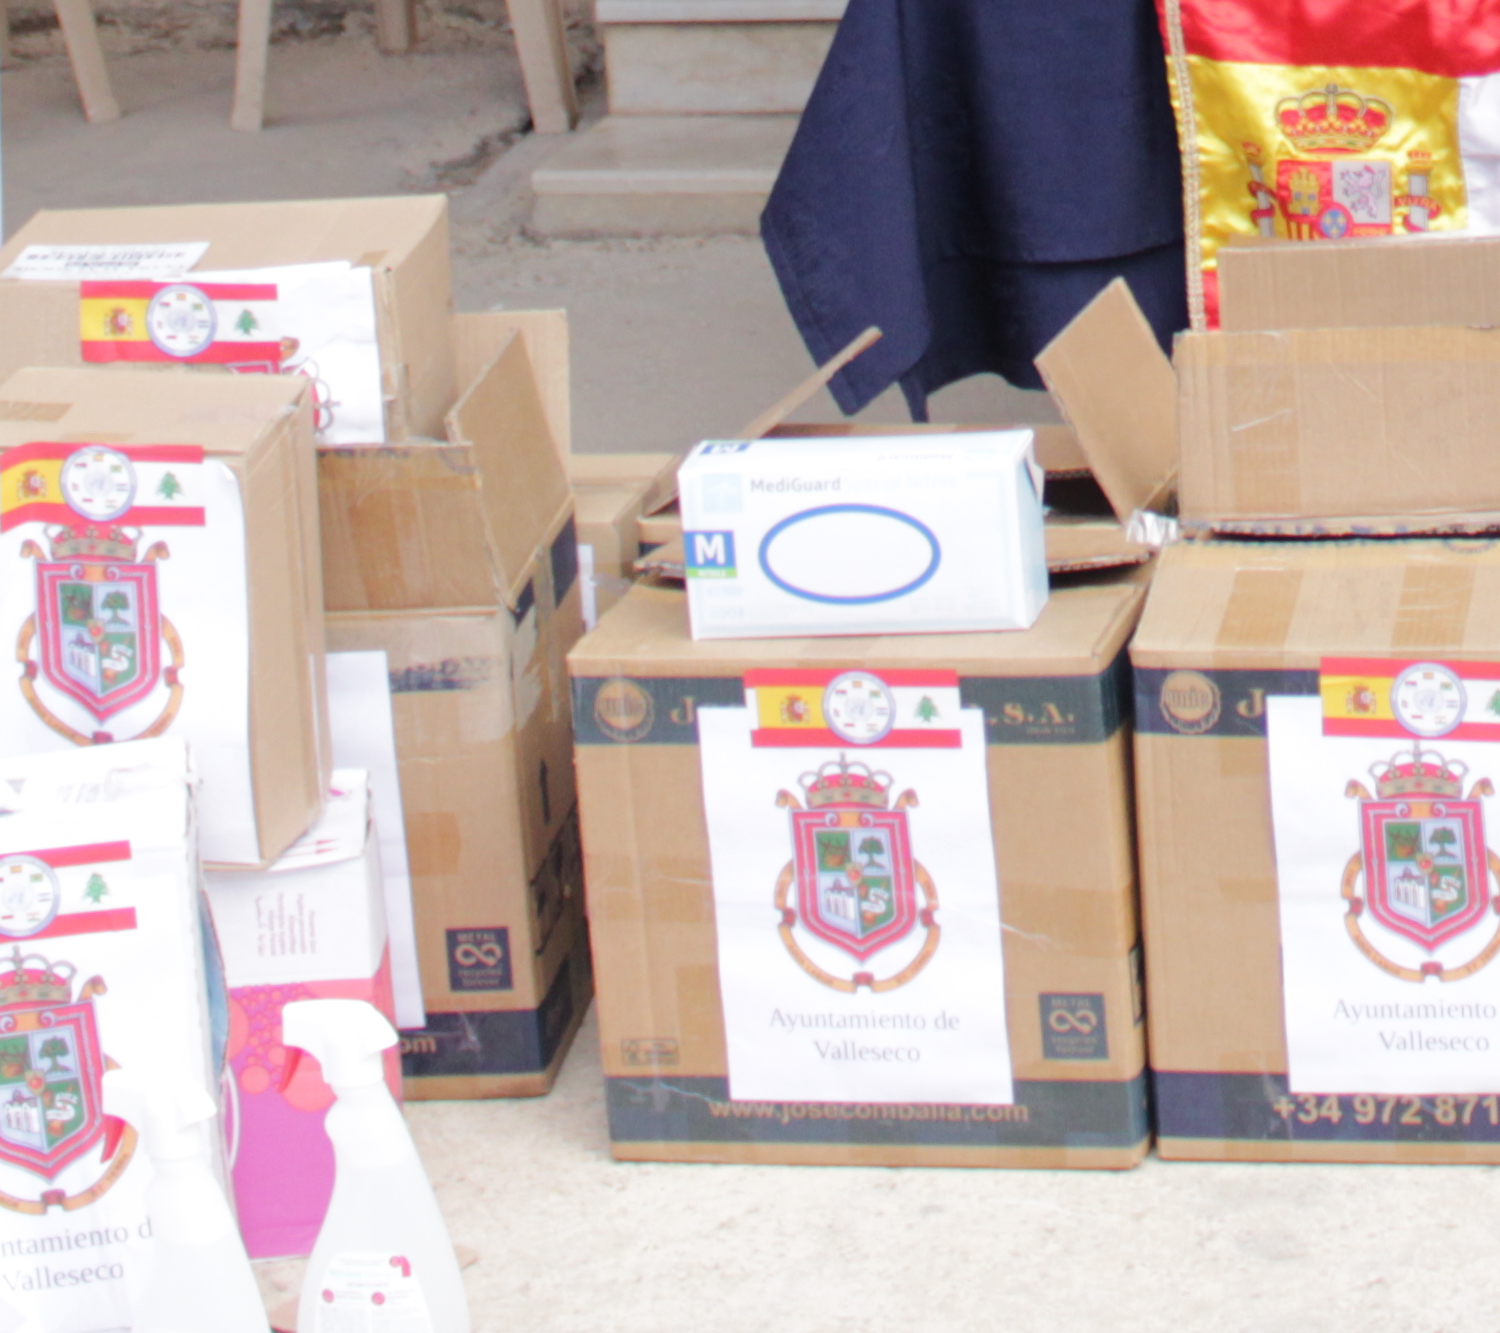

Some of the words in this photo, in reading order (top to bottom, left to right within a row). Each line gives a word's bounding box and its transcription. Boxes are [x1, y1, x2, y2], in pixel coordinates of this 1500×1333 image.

[749, 476, 842, 494] MediGuard
[694, 533, 727, 566] M
[768, 1008, 927, 1032] Ayuntamiento
[934, 1008, 961, 1031] de
[1332, 998, 1497, 1025] Ayuntamiento
[813, 1038, 921, 1063] Valleseco
[1377, 1029, 1490, 1053] Valleseco
[1272, 1095, 1342, 1125] +34
[1353, 1094, 1422, 1126] 972
[1433, 1094, 1500, 1126] 871
[137, 1217, 154, 1242] d
[2, 1259, 126, 1294] Valleseco
